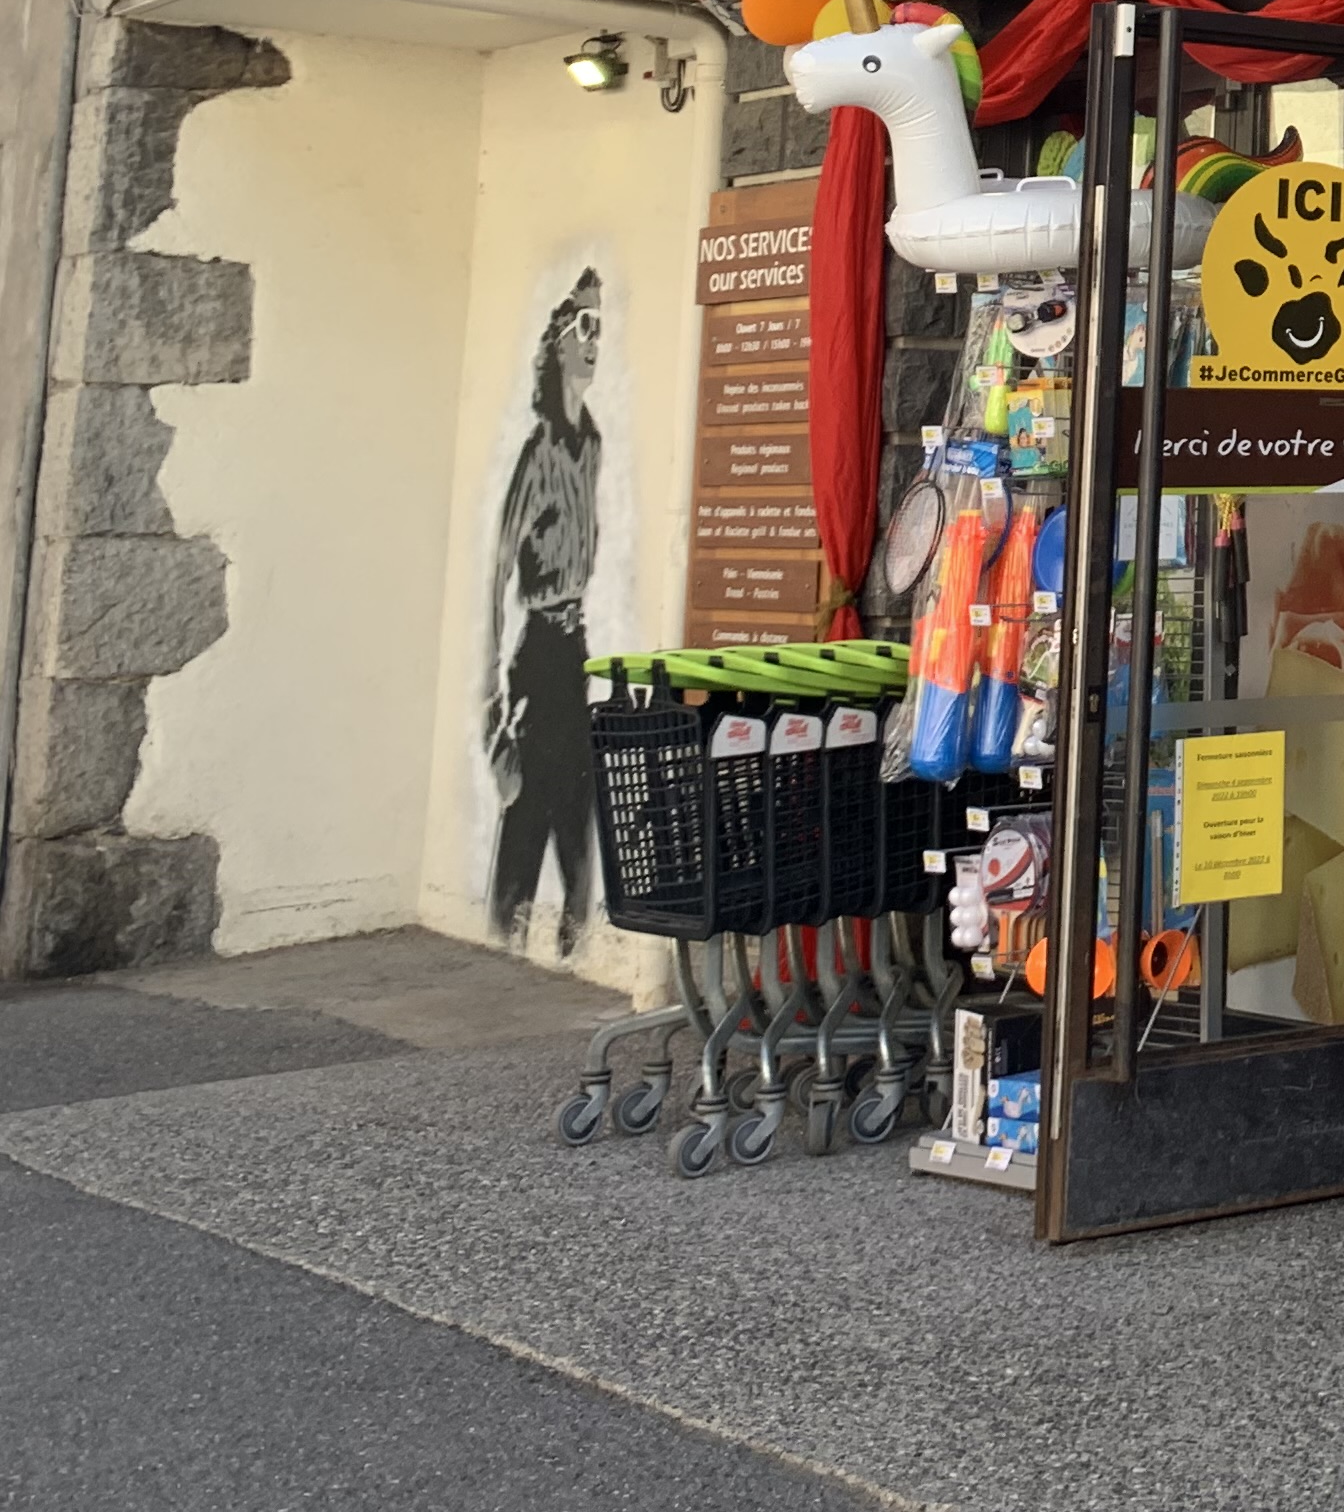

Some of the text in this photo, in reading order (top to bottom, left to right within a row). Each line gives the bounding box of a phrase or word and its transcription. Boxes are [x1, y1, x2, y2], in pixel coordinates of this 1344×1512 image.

[1277, 177, 1342, 222] ICI
[700, 234, 737, 263] NOS
[709, 261, 805, 292] our services
[1134, 426, 1208, 457] erci
[1218, 429, 1250, 457] de
[1258, 427, 1334, 457] votre
